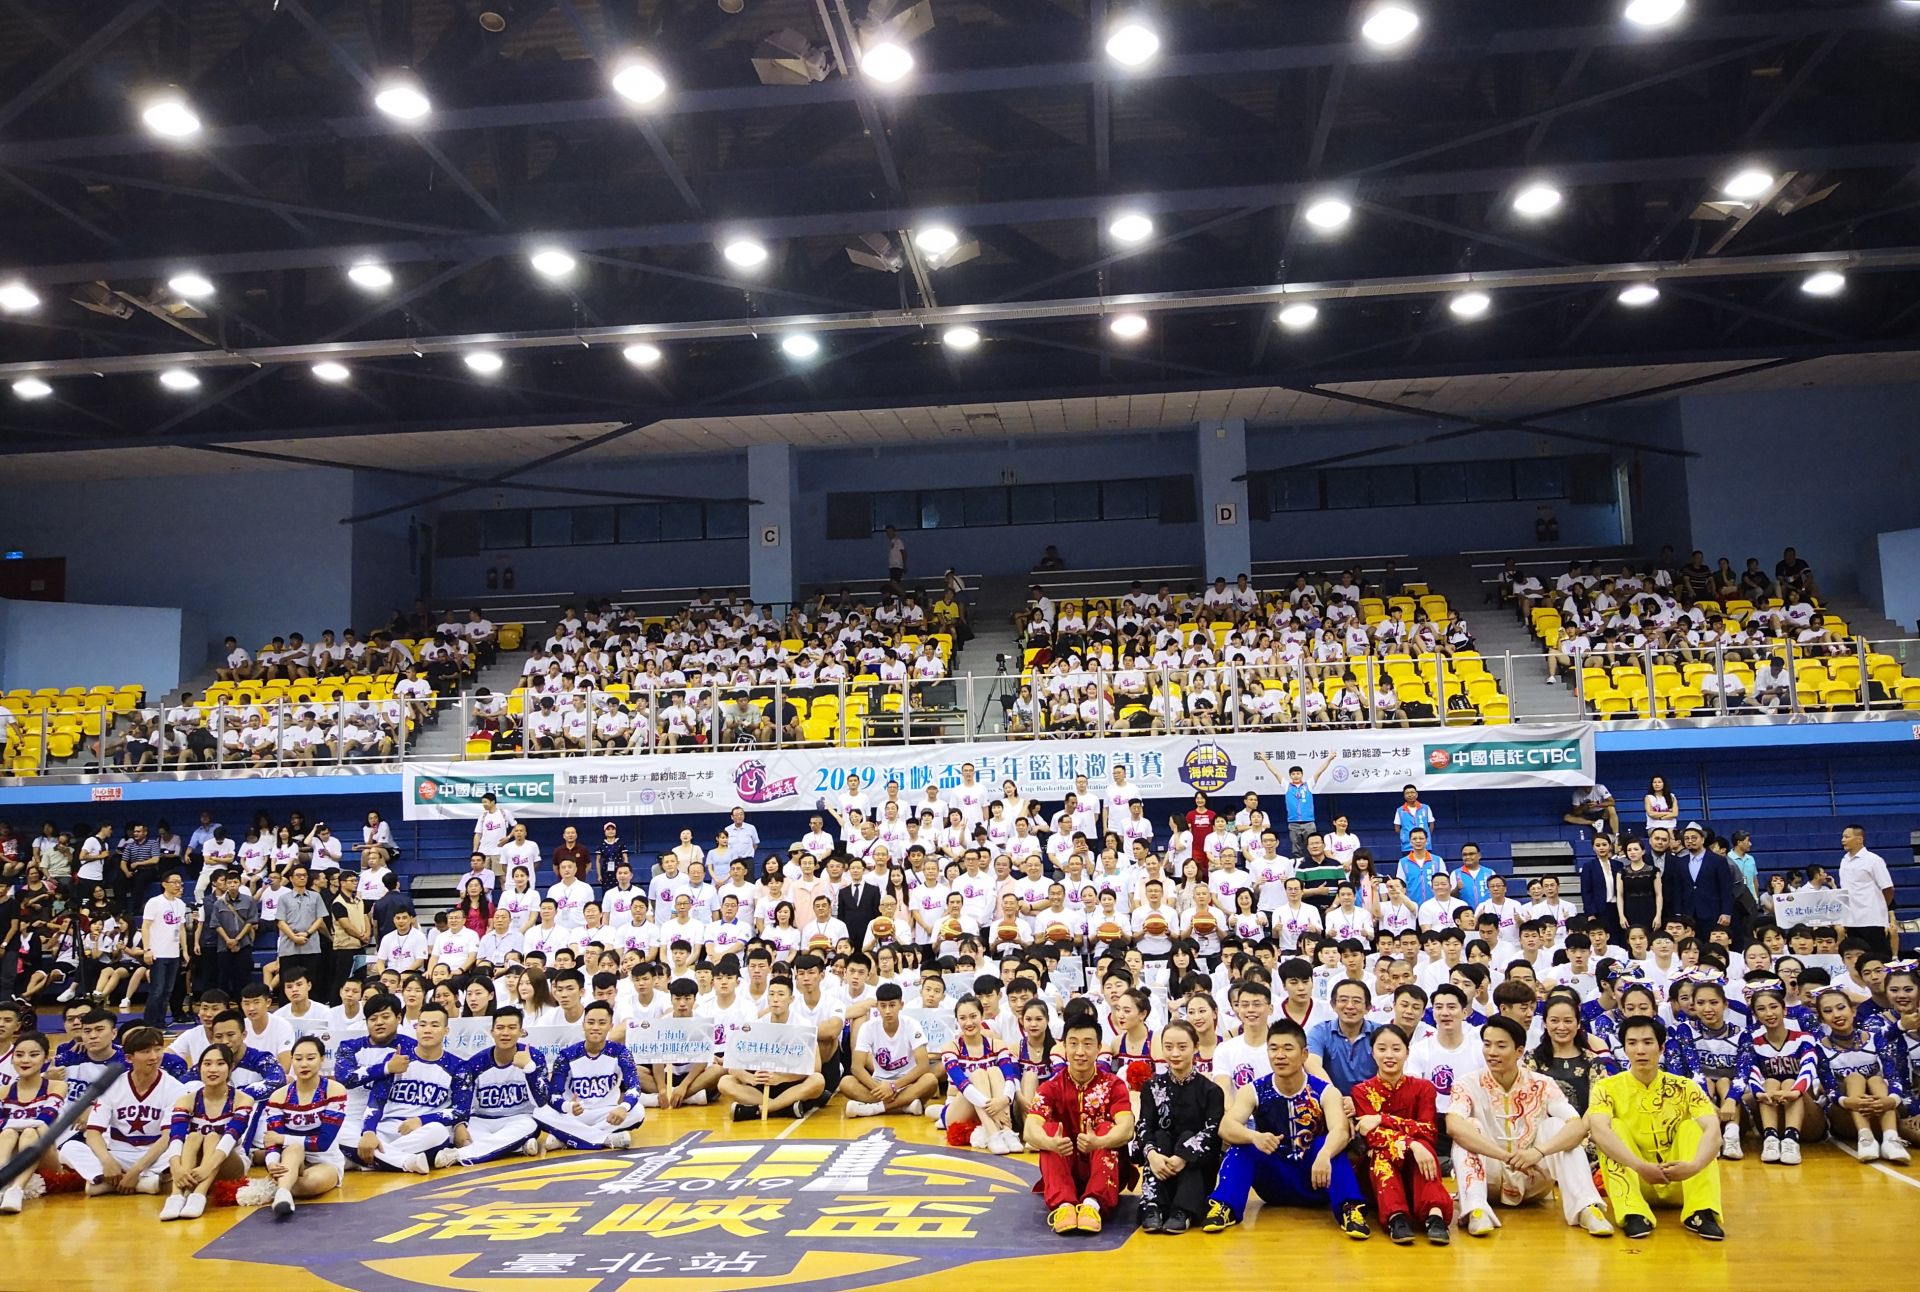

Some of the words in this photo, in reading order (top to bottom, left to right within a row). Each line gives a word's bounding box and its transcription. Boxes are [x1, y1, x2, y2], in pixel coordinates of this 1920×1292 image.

[1221, 508, 1232, 520] D
[765, 530, 775, 542] C
[1452, 749, 1525, 767] 中國信託
[1527, 748, 1577, 765] CTBC
[505, 781, 550, 797] CTBC
[1036, 783, 1073, 791] Basketball
[117, 1105, 162, 1120] ECNU
[640, 1178, 795, 1193] 2019
[373, 1195, 996, 1244] 海峽盃
[489, 1251, 768, 1273] 臺北站
